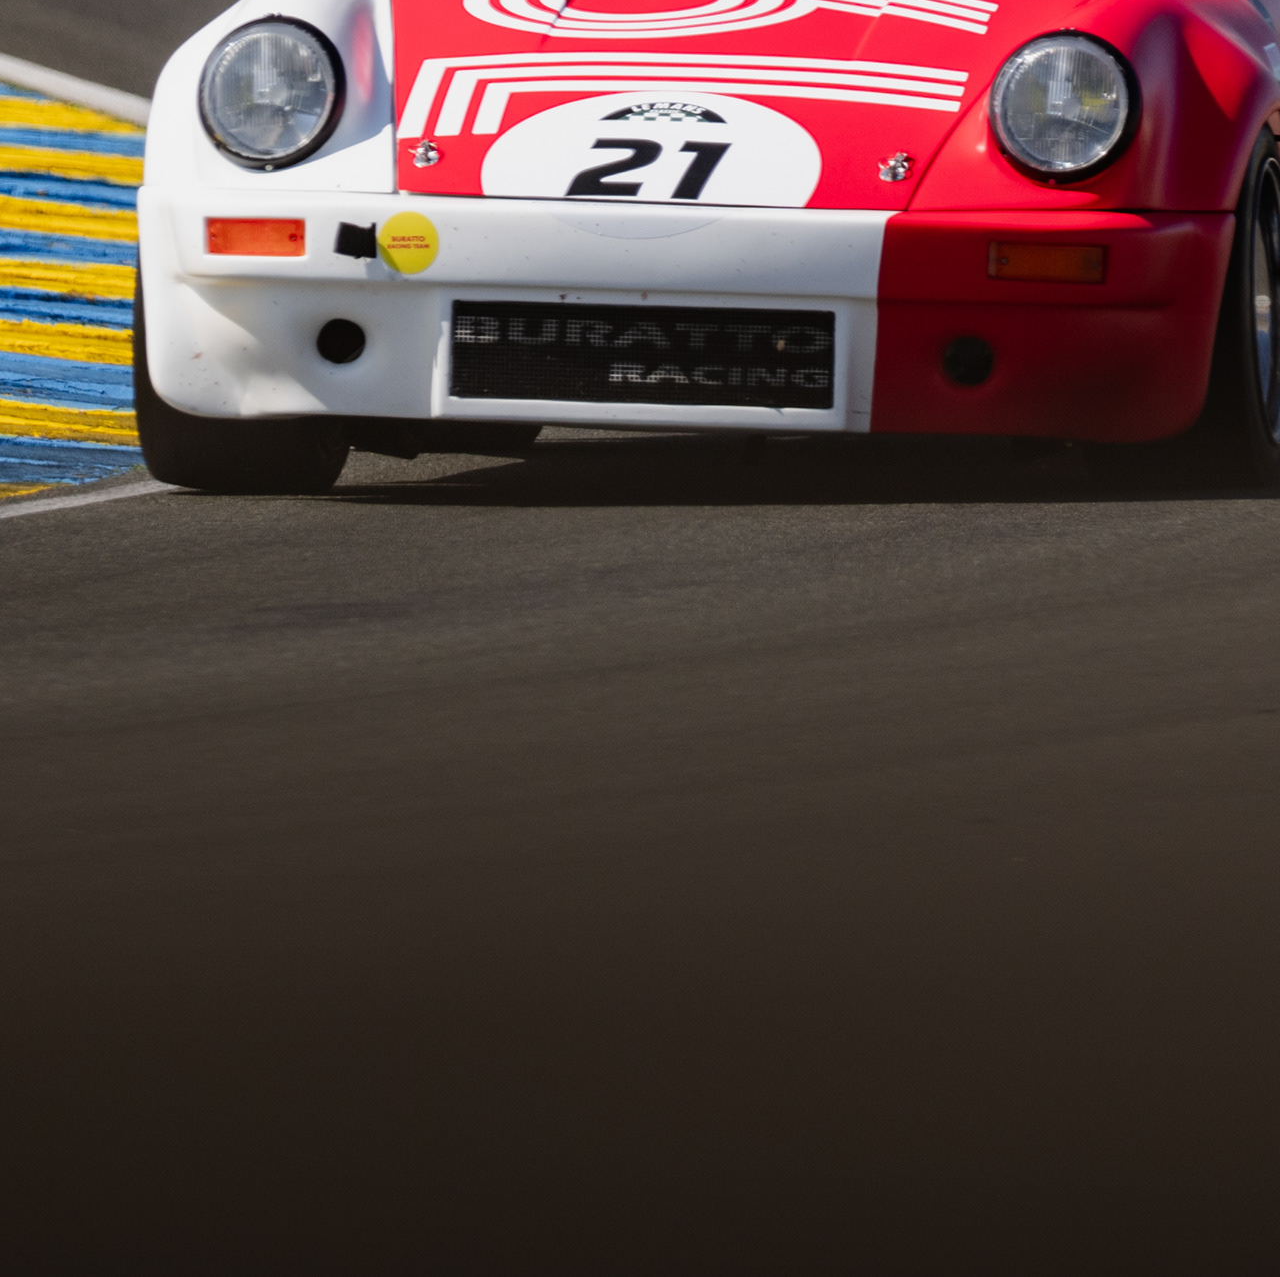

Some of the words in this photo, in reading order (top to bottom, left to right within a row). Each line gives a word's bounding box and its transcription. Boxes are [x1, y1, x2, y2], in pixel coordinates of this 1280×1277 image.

[631, 103, 651, 112] LE
[653, 102, 707, 115] MANS
[565, 135, 733, 201] 21
[453, 315, 833, 354] BURATTO
[608, 362, 831, 388] RACING
